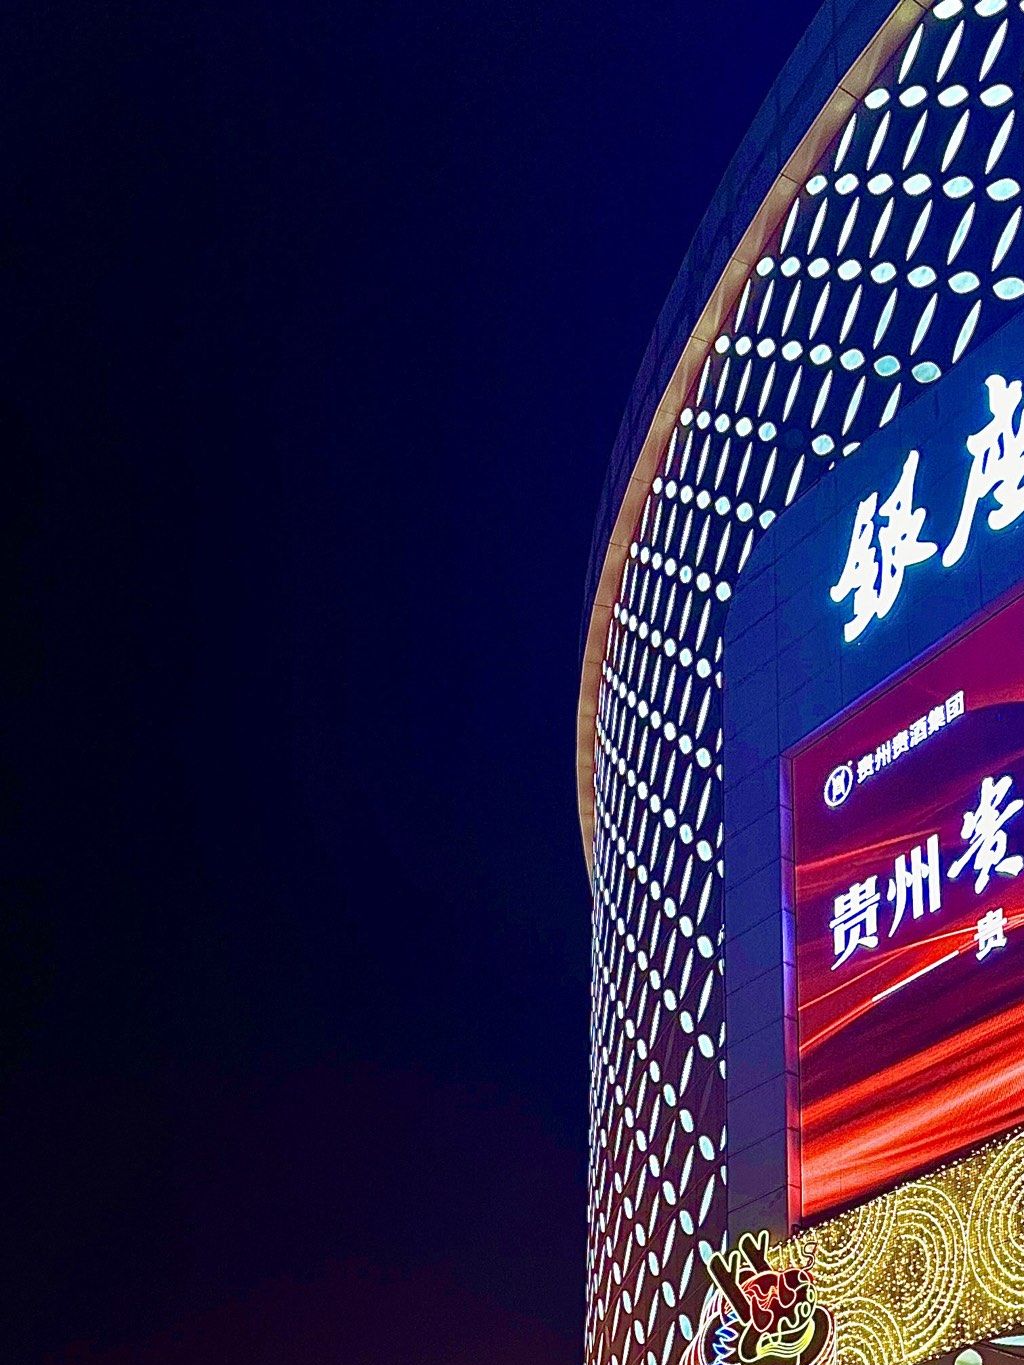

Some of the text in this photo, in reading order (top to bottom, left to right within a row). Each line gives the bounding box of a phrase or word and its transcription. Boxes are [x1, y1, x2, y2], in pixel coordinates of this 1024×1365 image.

[857, 690, 965, 784] 贵州贵酒集团
